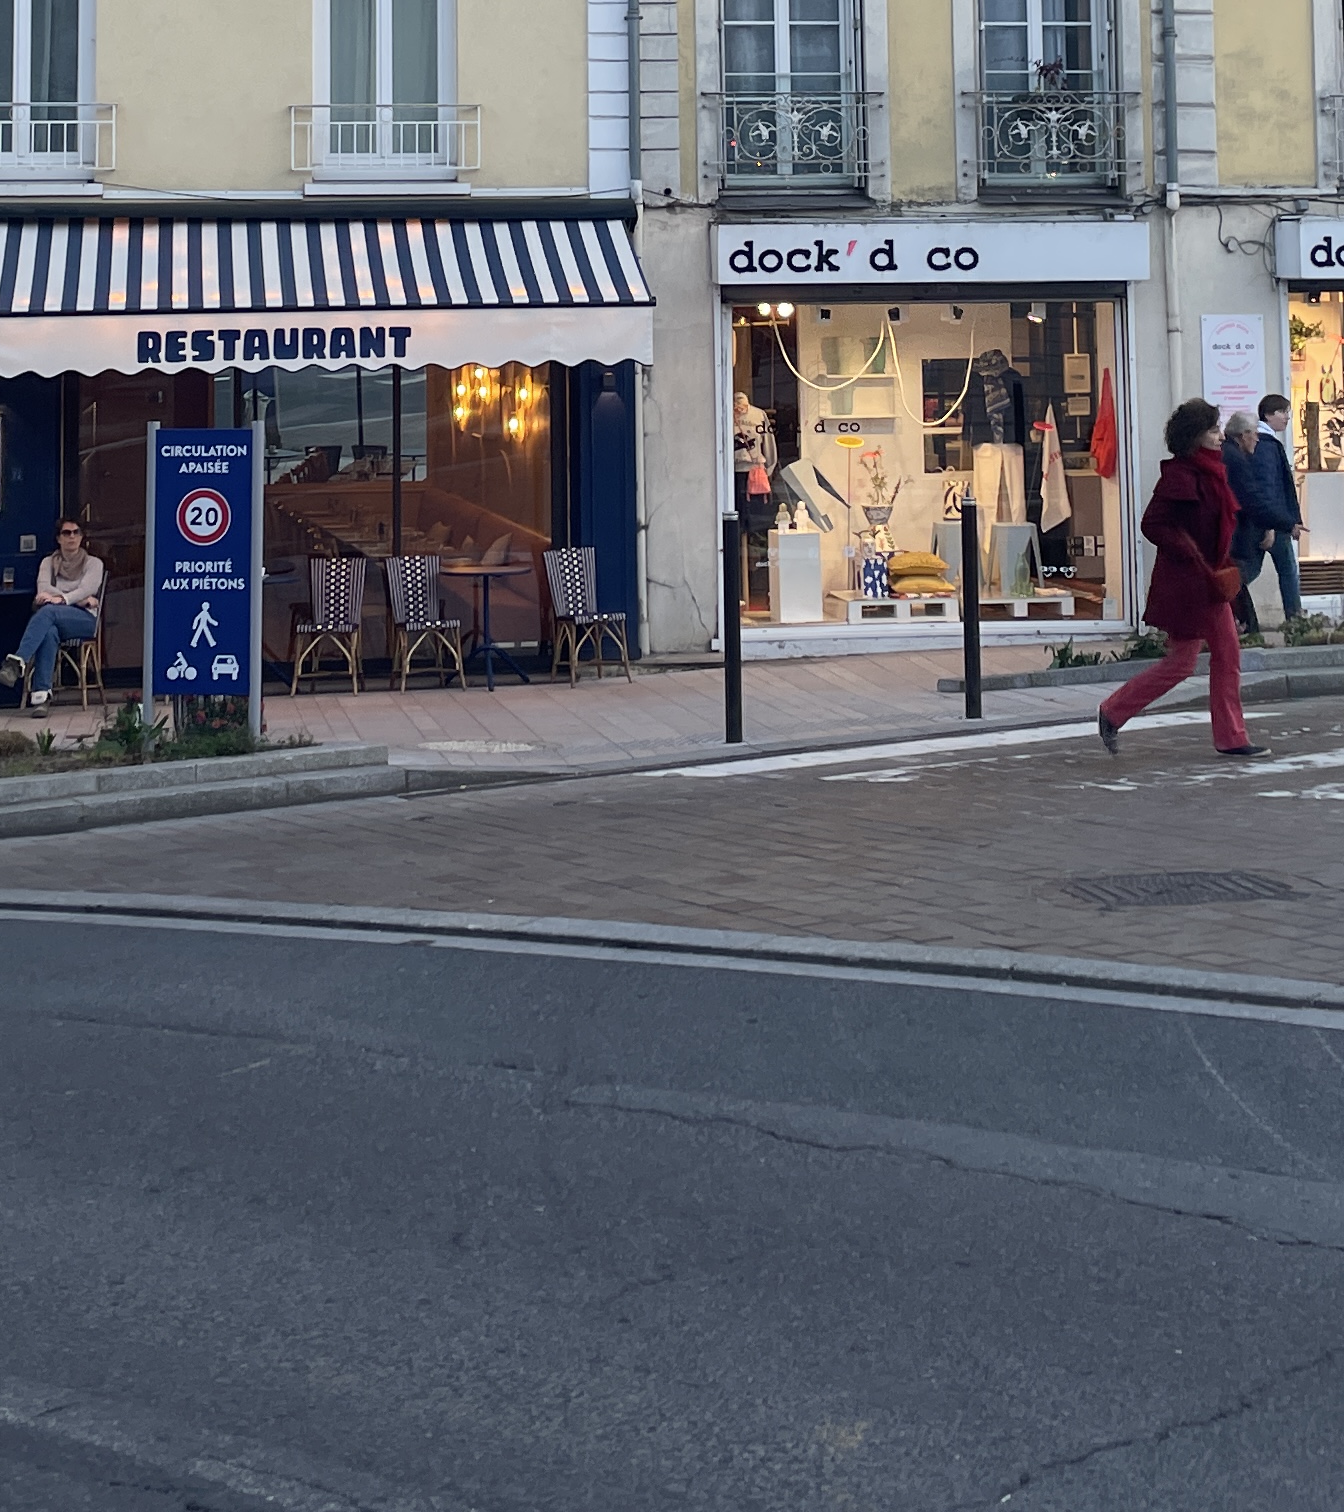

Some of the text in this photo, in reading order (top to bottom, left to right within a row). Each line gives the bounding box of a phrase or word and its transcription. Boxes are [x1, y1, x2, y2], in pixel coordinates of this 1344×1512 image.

[927, 247, 979, 271] co
[137, 326, 412, 363] RESTAURANT
[161, 445, 248, 457] CIRCULATION
[179, 459, 230, 474] APAISÉE
[190, 507, 218, 526] 20
[175, 558, 233, 573] PRIORITÉ
[162, 575, 246, 590] AUX PIÉTONS
